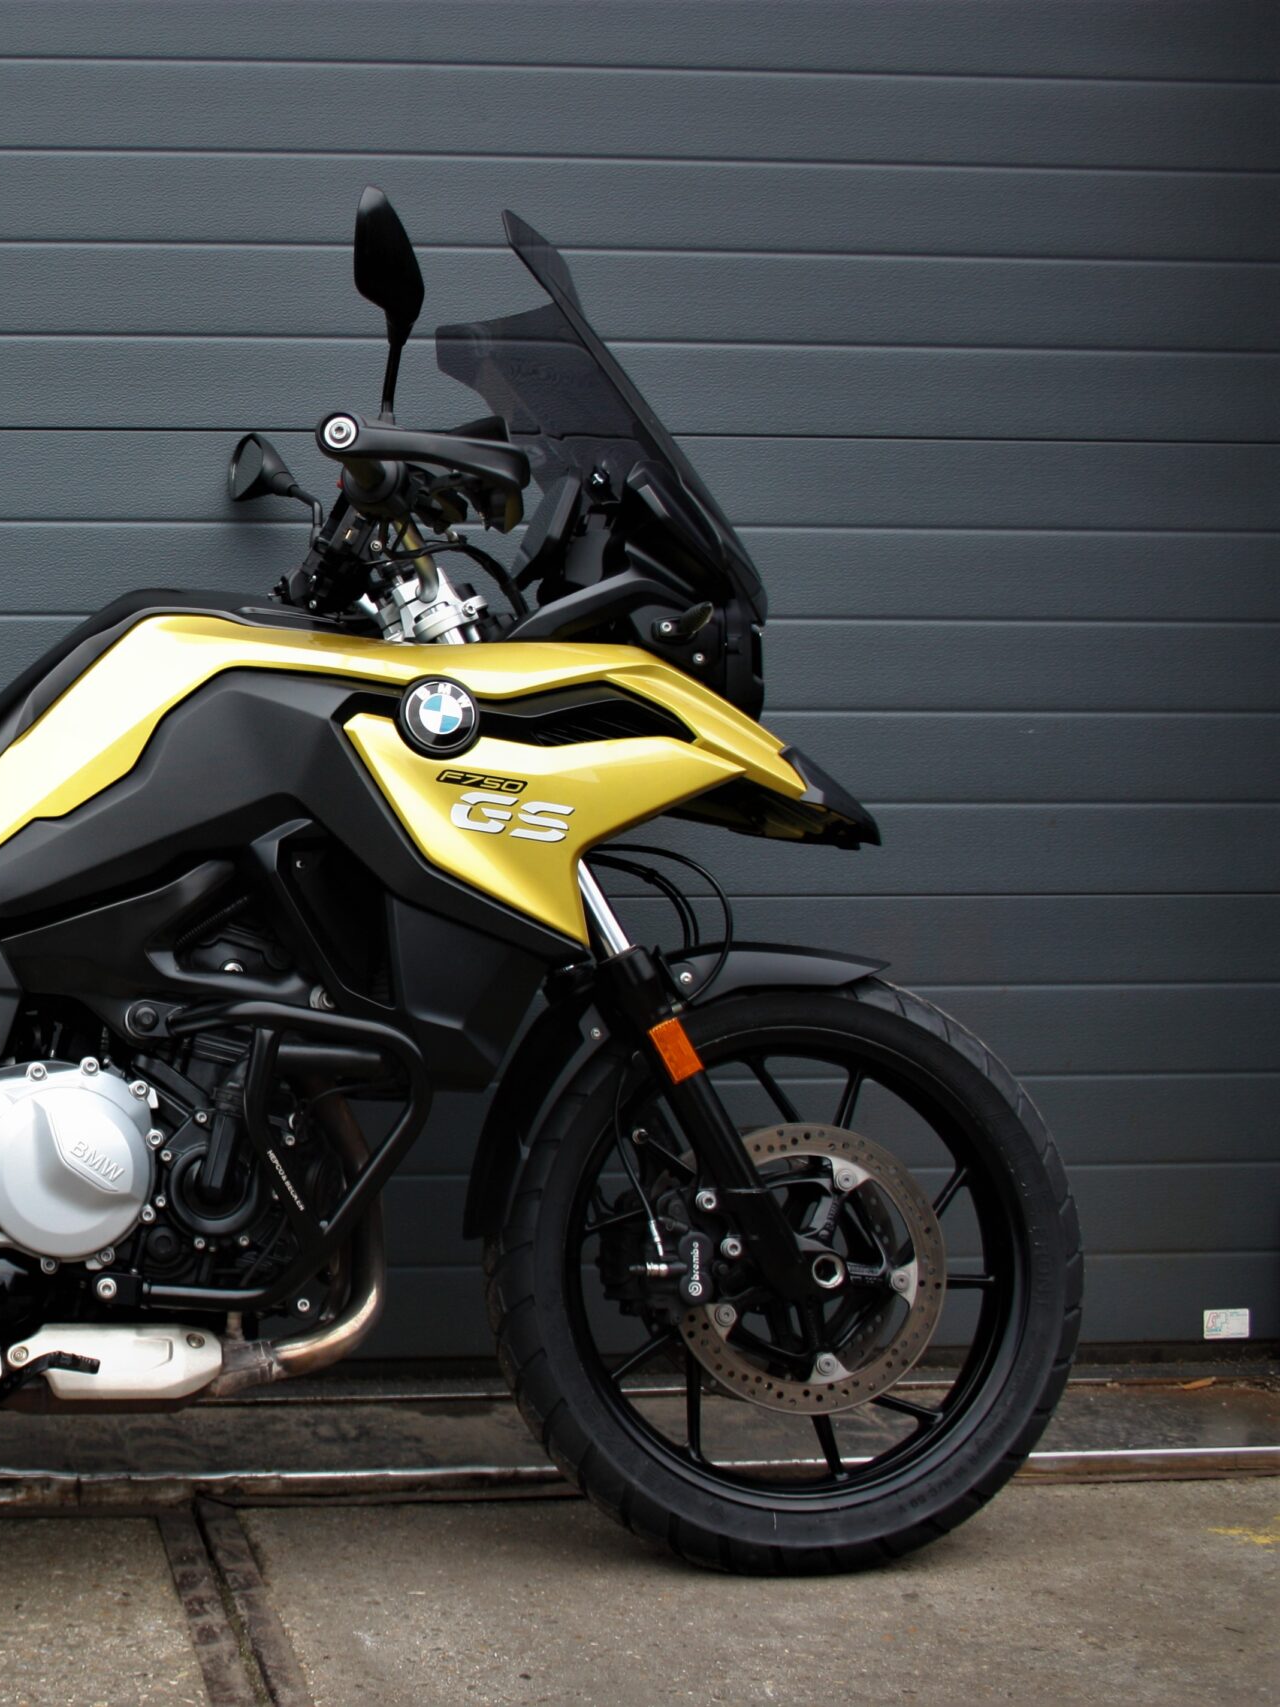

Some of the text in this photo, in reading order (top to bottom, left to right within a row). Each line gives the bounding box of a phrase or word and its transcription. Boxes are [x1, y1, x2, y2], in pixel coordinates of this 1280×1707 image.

[415, 682, 473, 710] BMW
[438, 770, 525, 793] F750
[450, 794, 576, 842] GS
[69, 1140, 125, 1182] BMW
[690, 1241, 701, 1281] brembo
